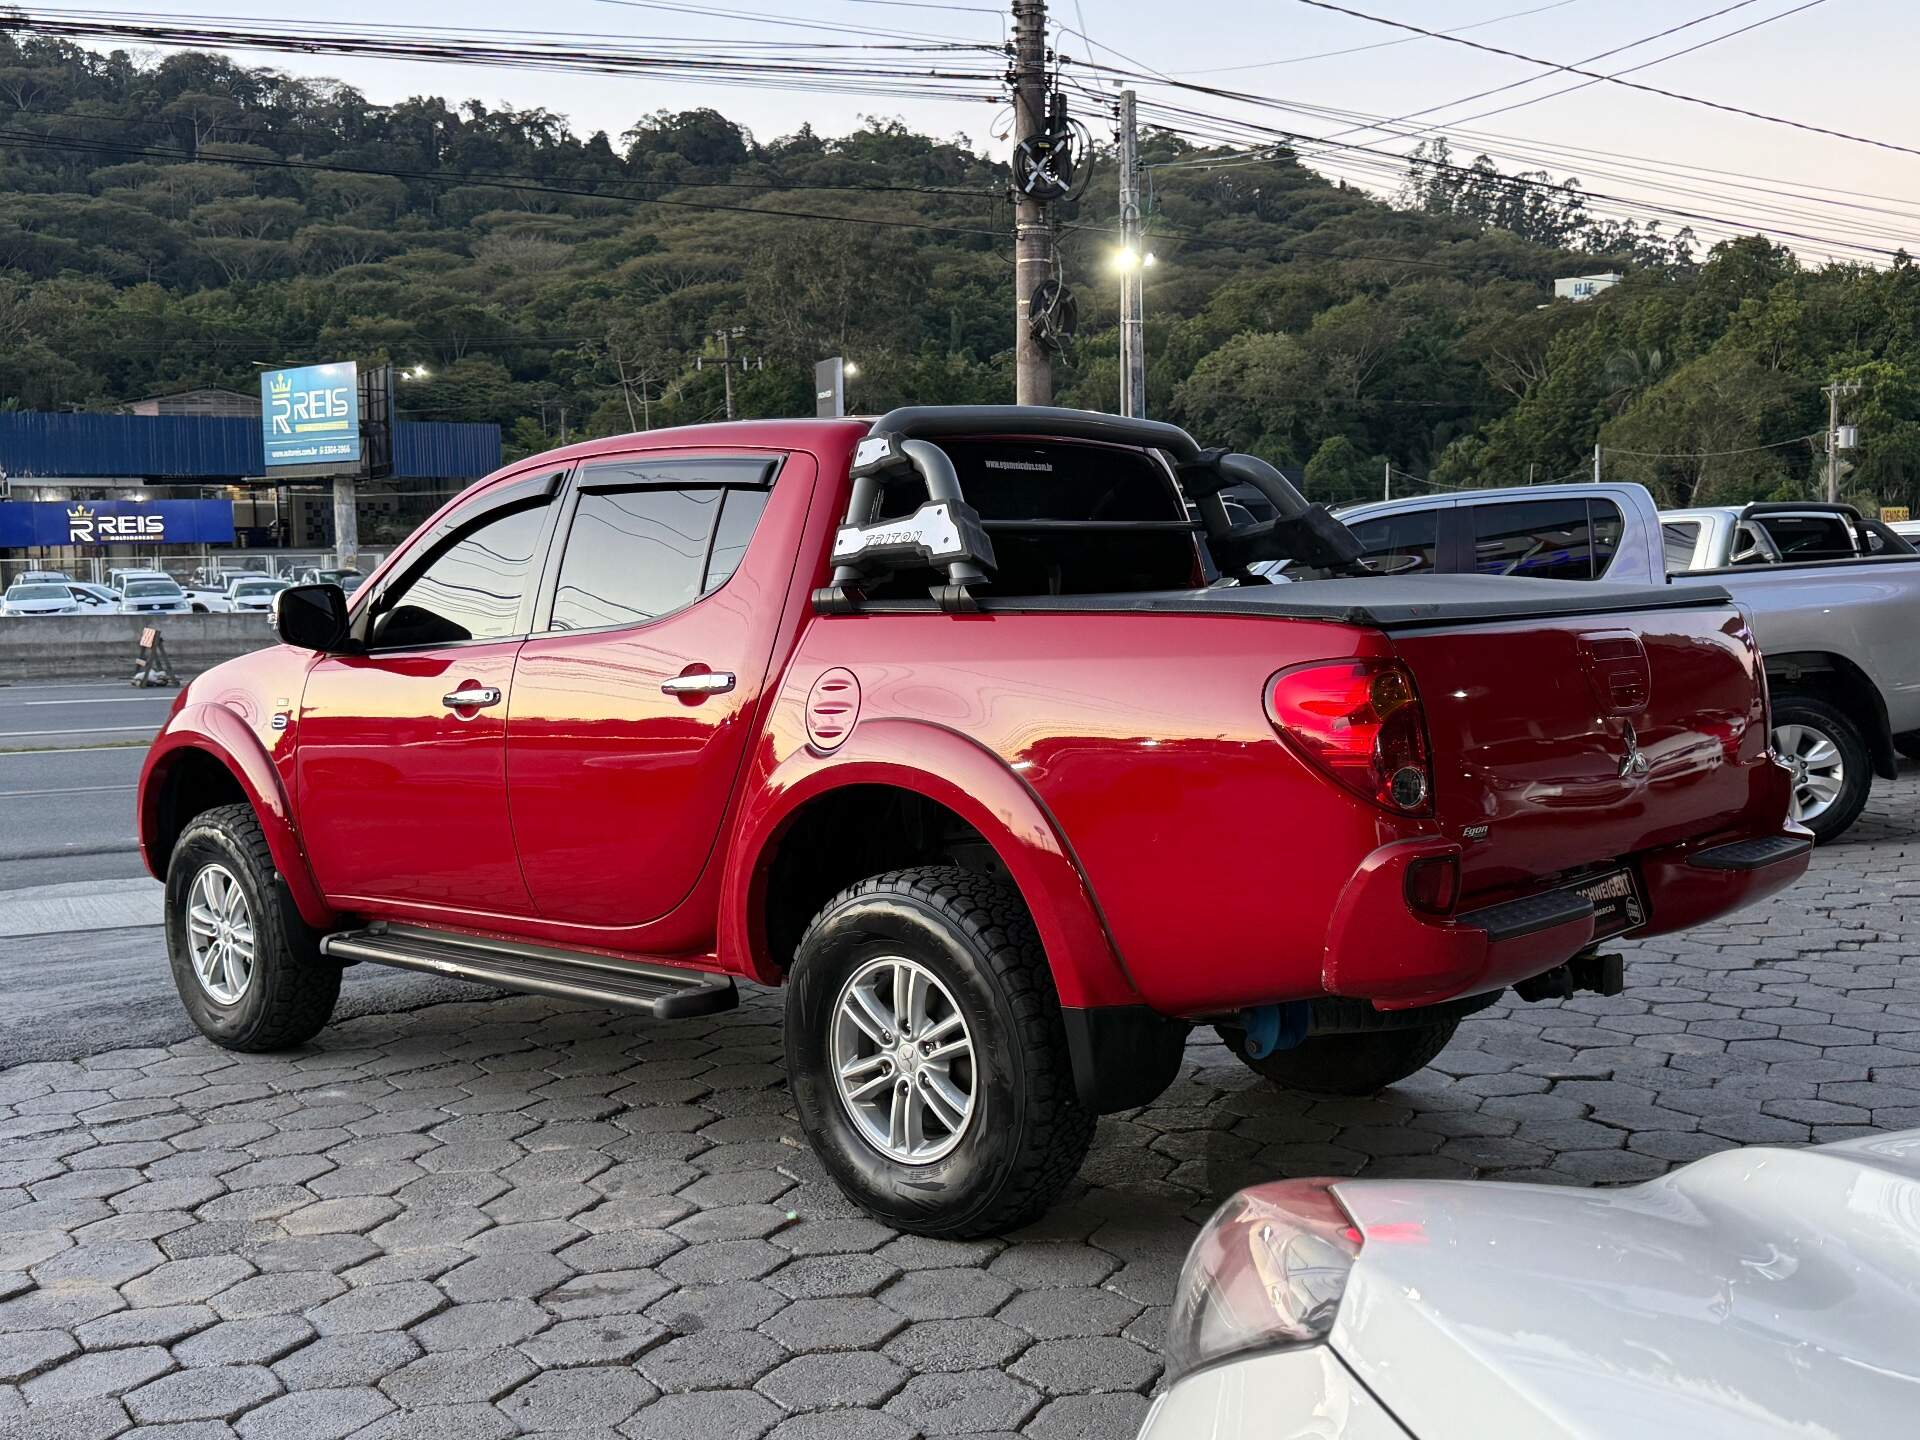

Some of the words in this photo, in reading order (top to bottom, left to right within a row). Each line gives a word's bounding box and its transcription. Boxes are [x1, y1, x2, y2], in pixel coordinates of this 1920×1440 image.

[293, 387, 348, 420] REIS
[97, 515, 165, 534] REIS
[865, 530, 923, 546] TRITON
[1462, 825, 1489, 838] Egon
